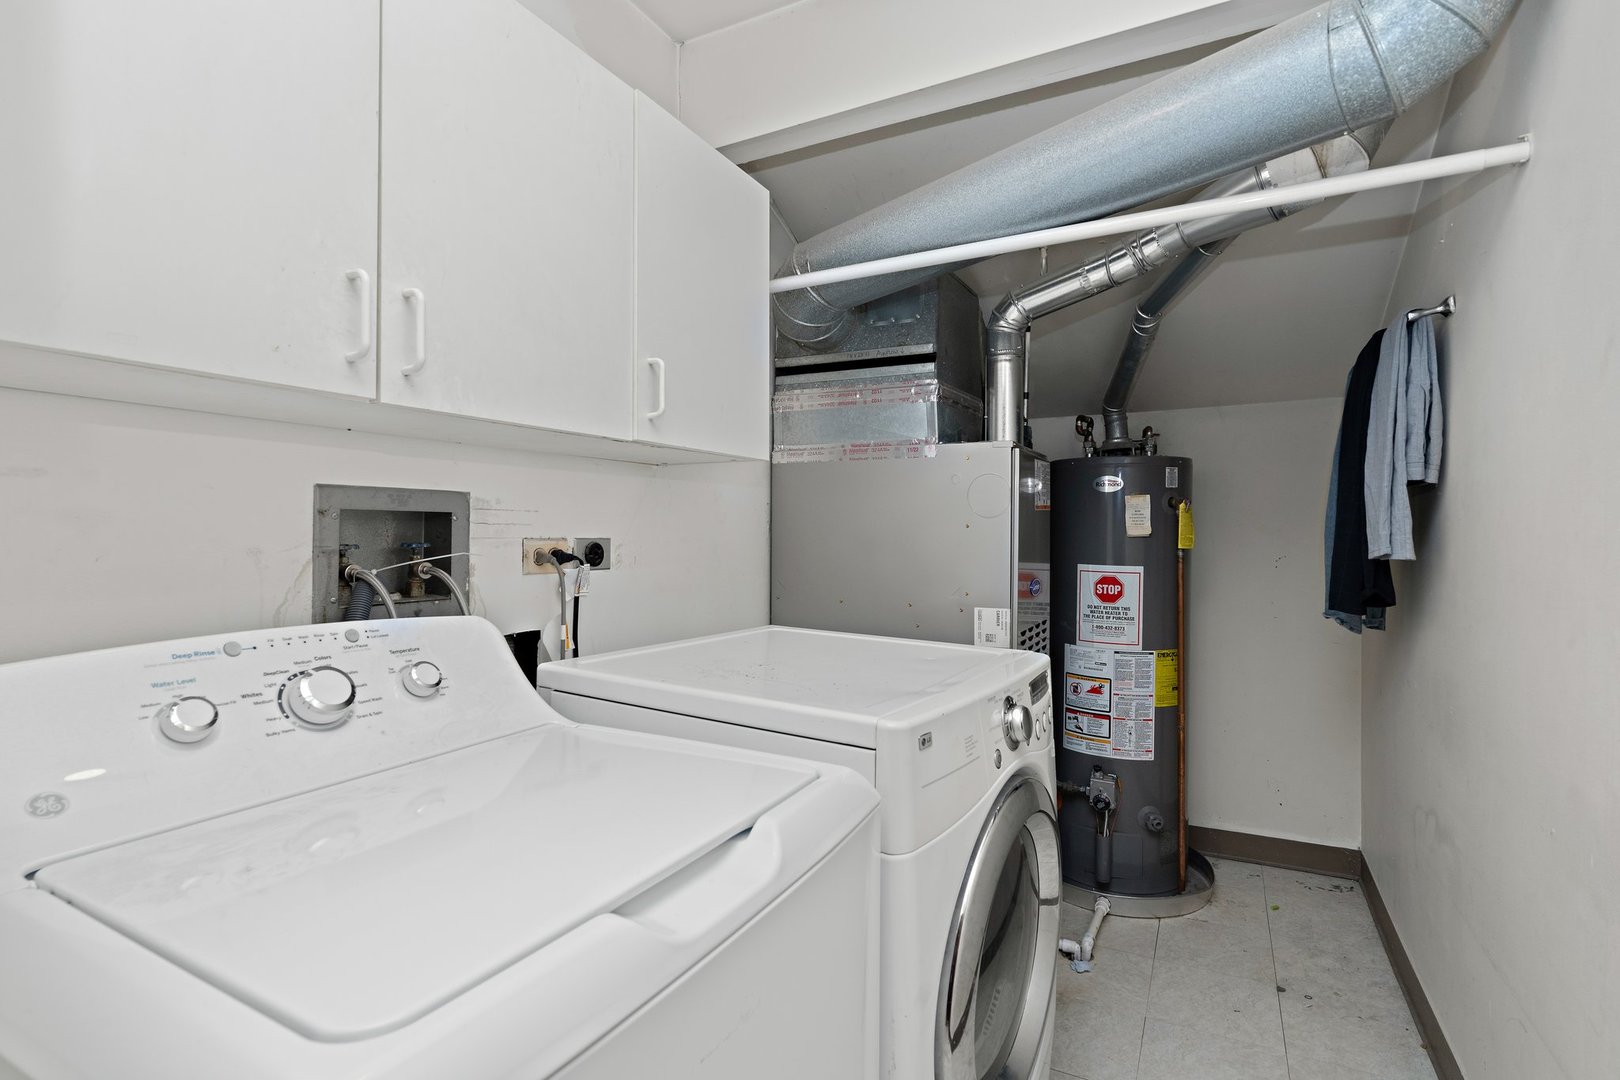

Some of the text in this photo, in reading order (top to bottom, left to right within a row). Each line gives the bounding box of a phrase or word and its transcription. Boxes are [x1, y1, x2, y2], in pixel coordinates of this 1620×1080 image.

[1096, 584, 1121, 595] STOP
[171, 649, 216, 661] Deep Rinse
[389, 647, 420, 655] Temperature
[177, 677, 197, 686] Level
